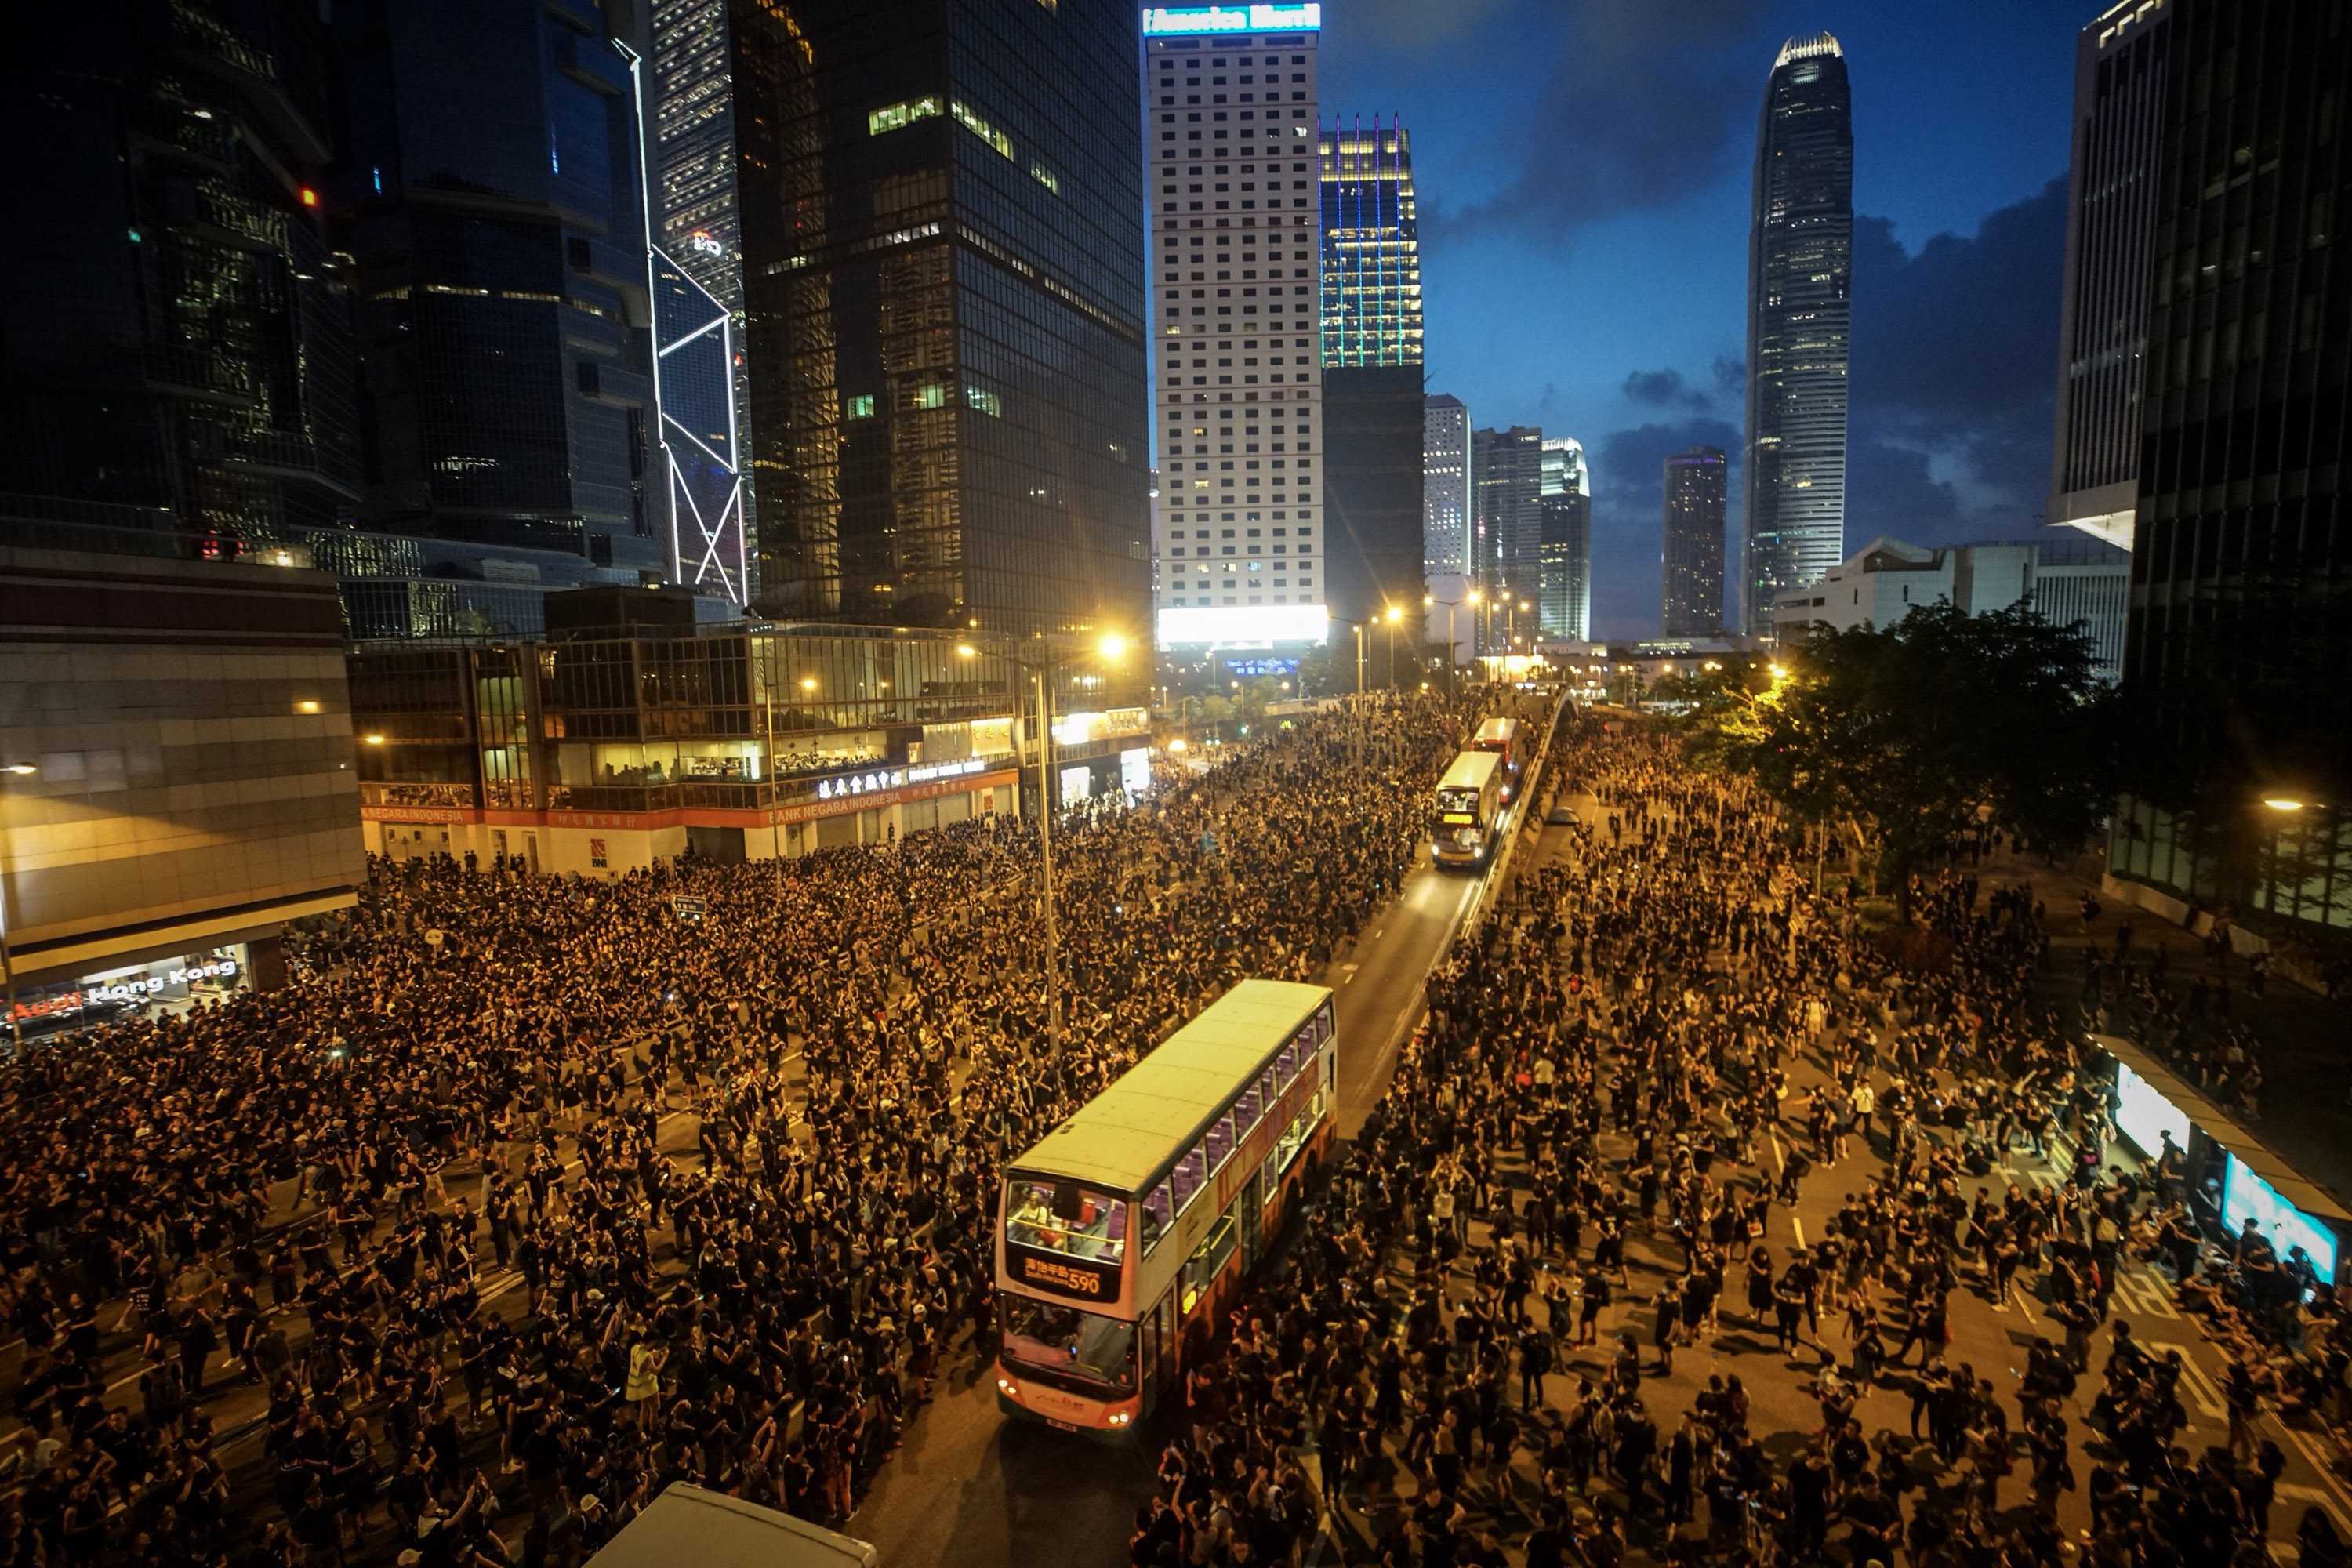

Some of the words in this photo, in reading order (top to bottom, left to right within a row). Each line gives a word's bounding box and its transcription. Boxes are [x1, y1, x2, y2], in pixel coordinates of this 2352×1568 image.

[370, 807, 408, 818] NEGARA
[409, 808, 463, 822] INDONESIA
[803, 800, 848, 818] NEGARA
[849, 792, 901, 810] INDONESIA
[592, 858, 608, 868] BNI
[88, 976, 165, 1005] Hong
[169, 960, 237, 985] Kong
[1068, 1272, 1100, 1294] 590
